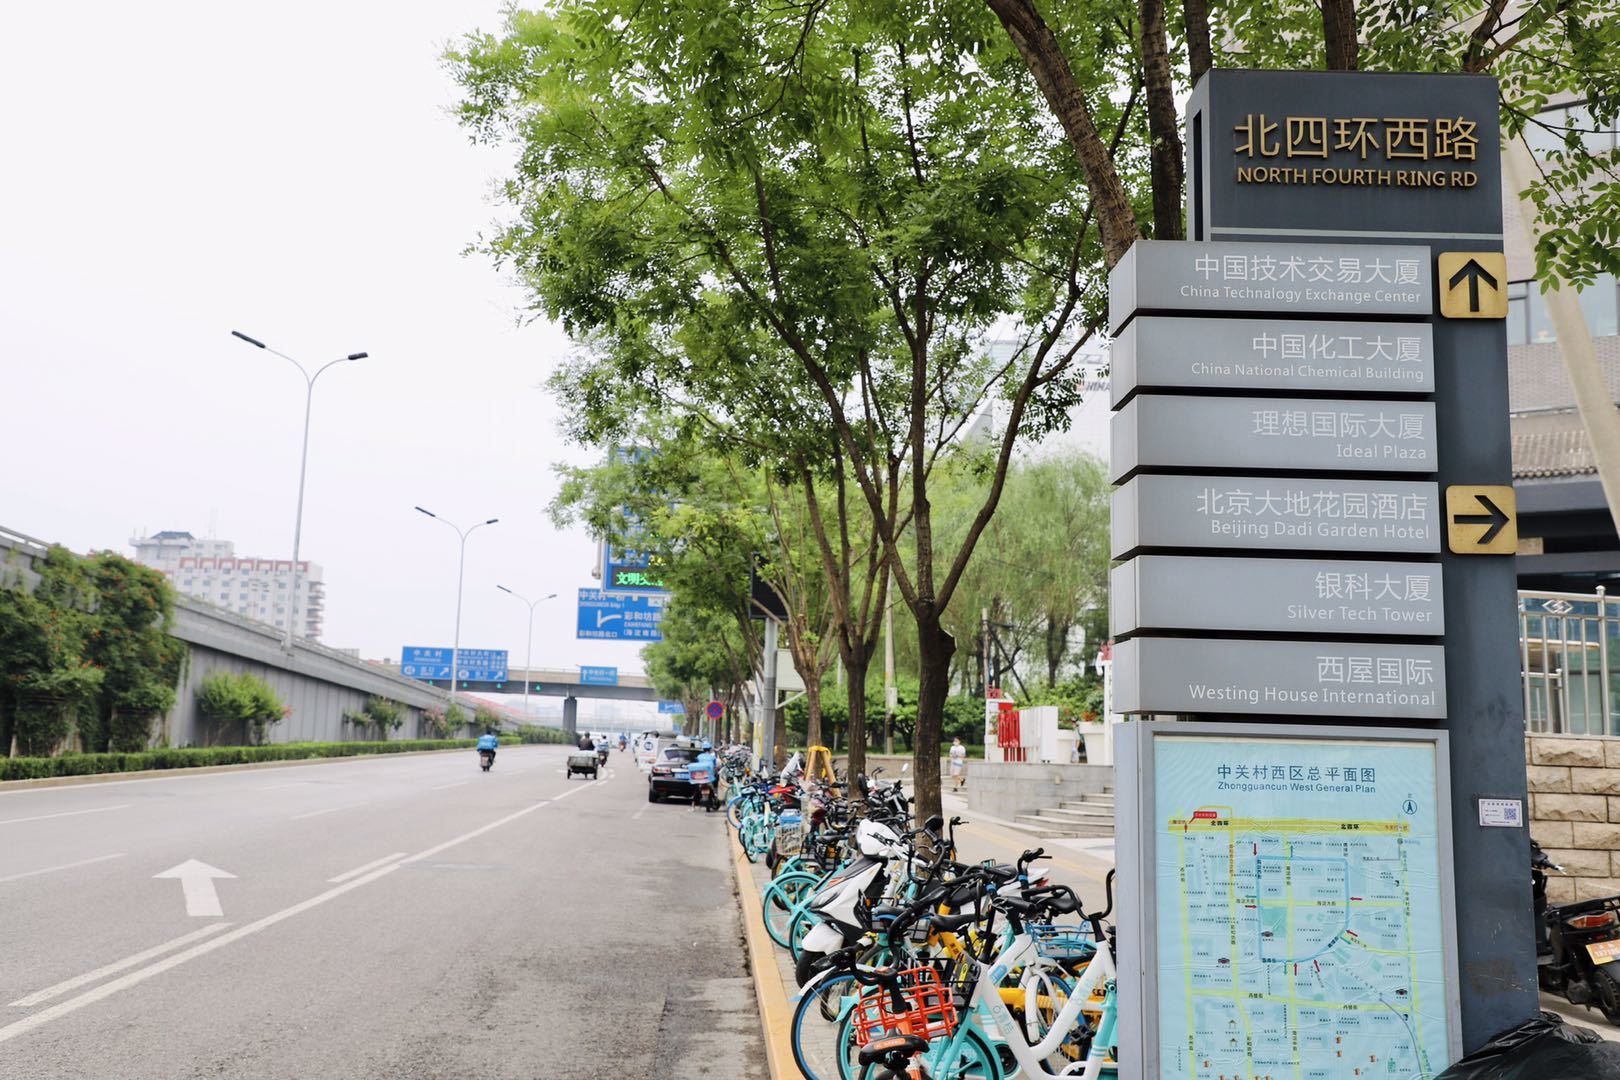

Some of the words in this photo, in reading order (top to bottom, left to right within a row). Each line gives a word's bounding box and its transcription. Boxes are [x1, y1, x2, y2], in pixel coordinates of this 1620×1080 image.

[1234, 113, 1479, 161] 北四环西路
[1237, 167, 1307, 185] NORTH
[1312, 168, 1391, 186] FOURTH
[1397, 169, 1446, 187] RING
[1450, 171, 1478, 188] RD
[1194, 253, 1421, 285] 中国技术交易大厦
[1180, 285, 1219, 298] China
[1305, 288, 1371, 305] Exchange
[1374, 290, 1421, 303] Center
[1252, 332, 1423, 363] 中国化工大厦
[1191, 362, 1231, 376] China
[1234, 363, 1294, 378] National
[1298, 364, 1361, 379] Chemical
[1366, 366, 1424, 383] Building
[1252, 410, 1425, 441] 理想国际大厦
[1336, 443, 1377, 458] Ideal
[1383, 444, 1427, 460] Plaza
[1196, 488, 1428, 521] 北京大地花园酒店
[1211, 519, 1269, 538] Beijing
[1274, 521, 1312, 537] Dadi
[1317, 522, 1378, 538] Garden
[1383, 524, 1430, 540] Hotel
[1315, 572, 1432, 602] 银科大厦
[1287, 605, 1334, 621] Silver
[1339, 606, 1377, 621] Tech
[1381, 607, 1432, 623] Tower
[1317, 655, 1433, 686] 西屋国际
[1189, 684, 1258, 705] Westing
[1264, 687, 1318, 703] House
[1322, 687, 1435, 706] International
[1217, 764, 1376, 783] 中关村西区总平面图
[1217, 781, 1288, 791] Zhongguancun
[1290, 783, 1313, 792] West
[1316, 783, 1353, 793] General
[1355, 784, 1376, 793] Plan
